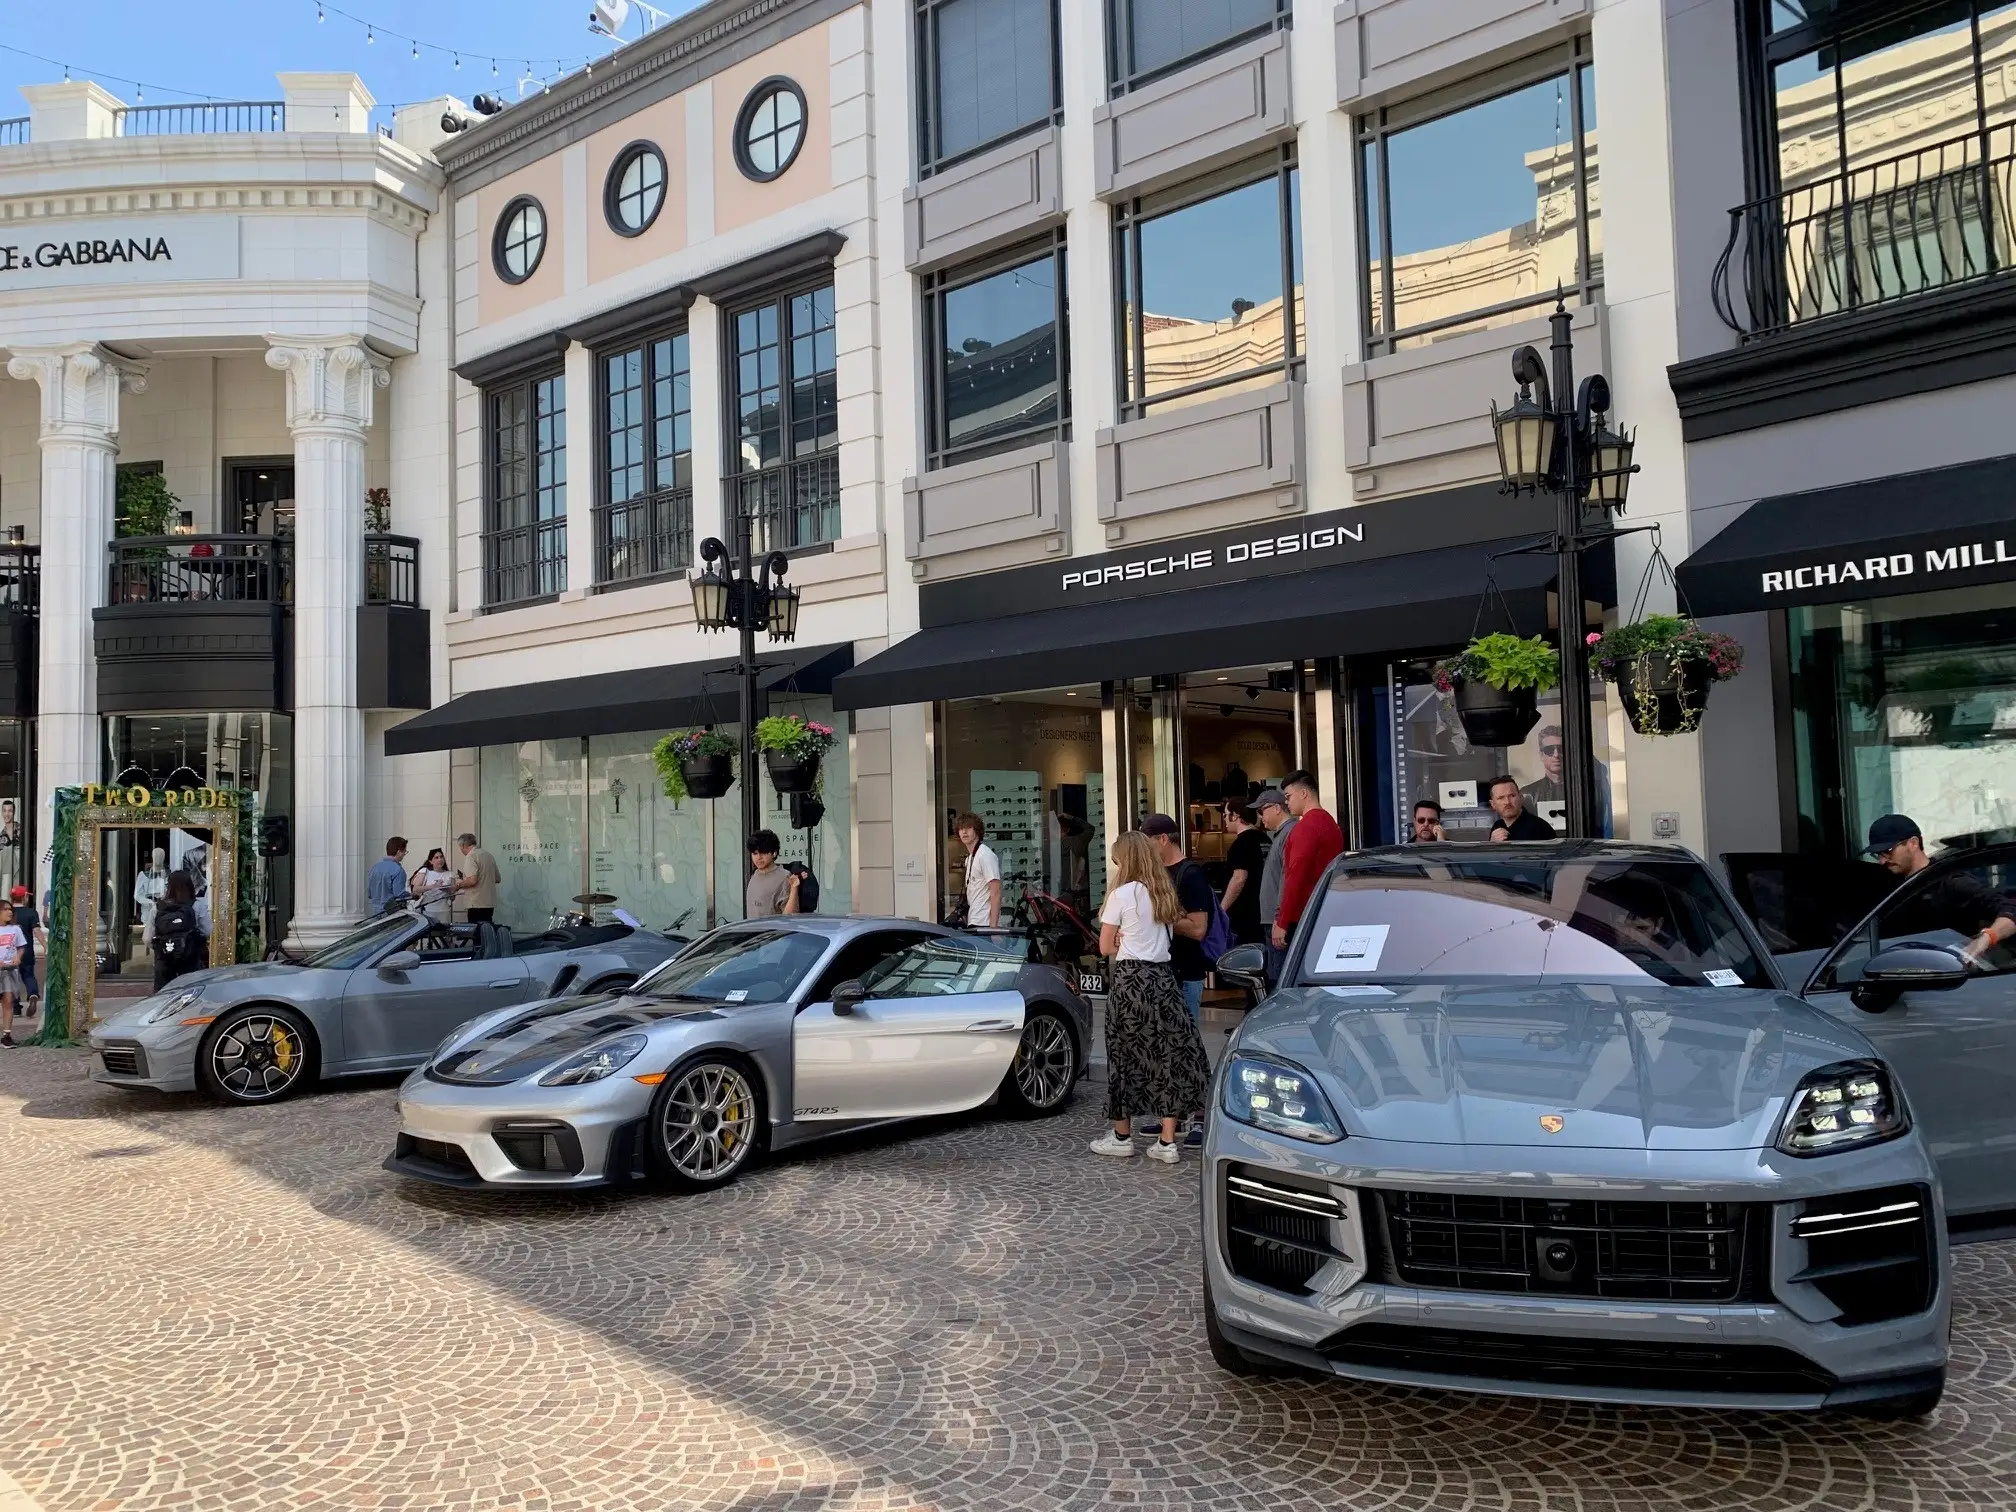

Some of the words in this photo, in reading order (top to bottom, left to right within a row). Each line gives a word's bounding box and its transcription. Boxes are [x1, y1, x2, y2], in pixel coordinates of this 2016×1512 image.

[35, 237, 172, 268] GABBANA
[1062, 549, 1213, 591] PORSCHE
[1226, 523, 1364, 564] DESIGN
[1762, 553, 1914, 593] RICHARD
[1925, 539, 2016, 573] MILL
[81, 782, 150, 808] TWO
[534, 842, 560, 850] SPACE
[785, 833, 819, 843] SPAE
[1081, 975, 1101, 990] 232
